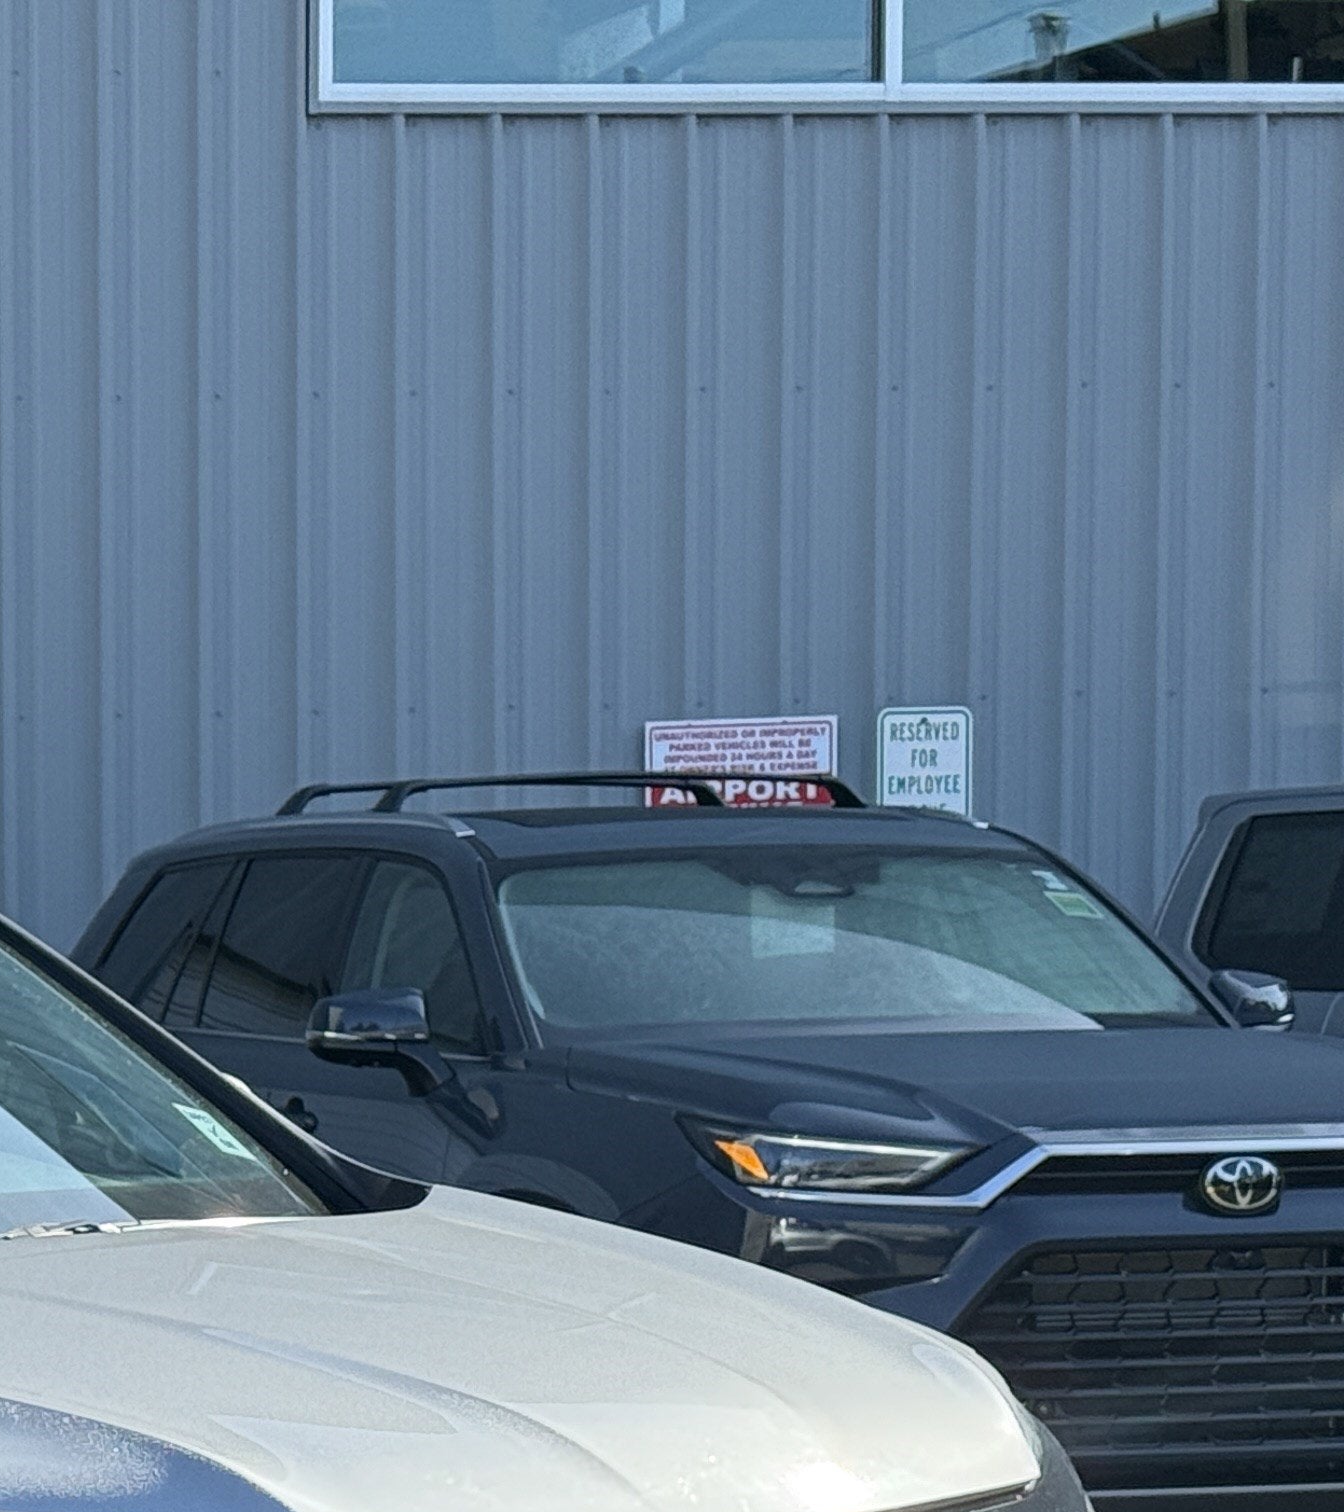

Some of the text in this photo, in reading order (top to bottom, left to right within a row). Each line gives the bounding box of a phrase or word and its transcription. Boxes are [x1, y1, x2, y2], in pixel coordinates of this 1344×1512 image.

[653, 726, 827, 742] UNAUTHORIZED OR IMPROPERLY
[889, 721, 960, 742] RESERVED
[668, 738, 812, 752] PARKED VEHICLES WILL BE
[745, 751, 783, 761] HOURS
[796, 749, 818, 760] DAY
[910, 748, 938, 768] FOR
[887, 774, 961, 795] EMPLOYEE
